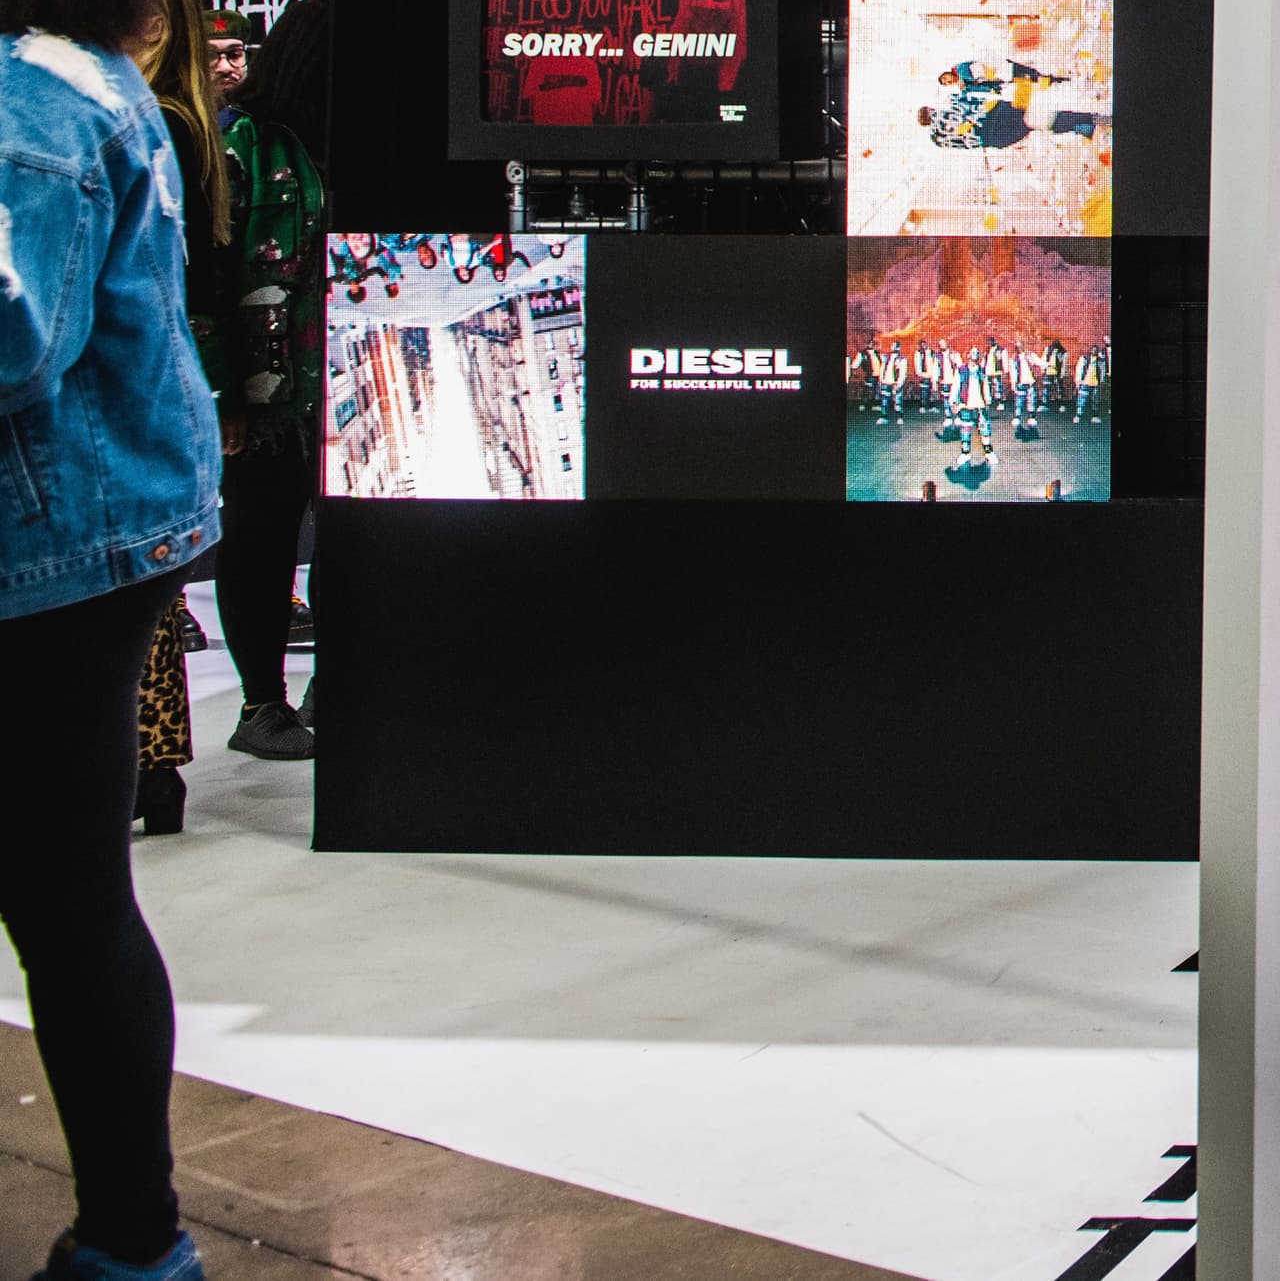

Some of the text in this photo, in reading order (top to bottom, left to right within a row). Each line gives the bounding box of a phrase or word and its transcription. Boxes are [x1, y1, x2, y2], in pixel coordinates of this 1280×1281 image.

[502, 32, 738, 58] SORRY... GEMINI
[630, 348, 802, 375] DIESEL
